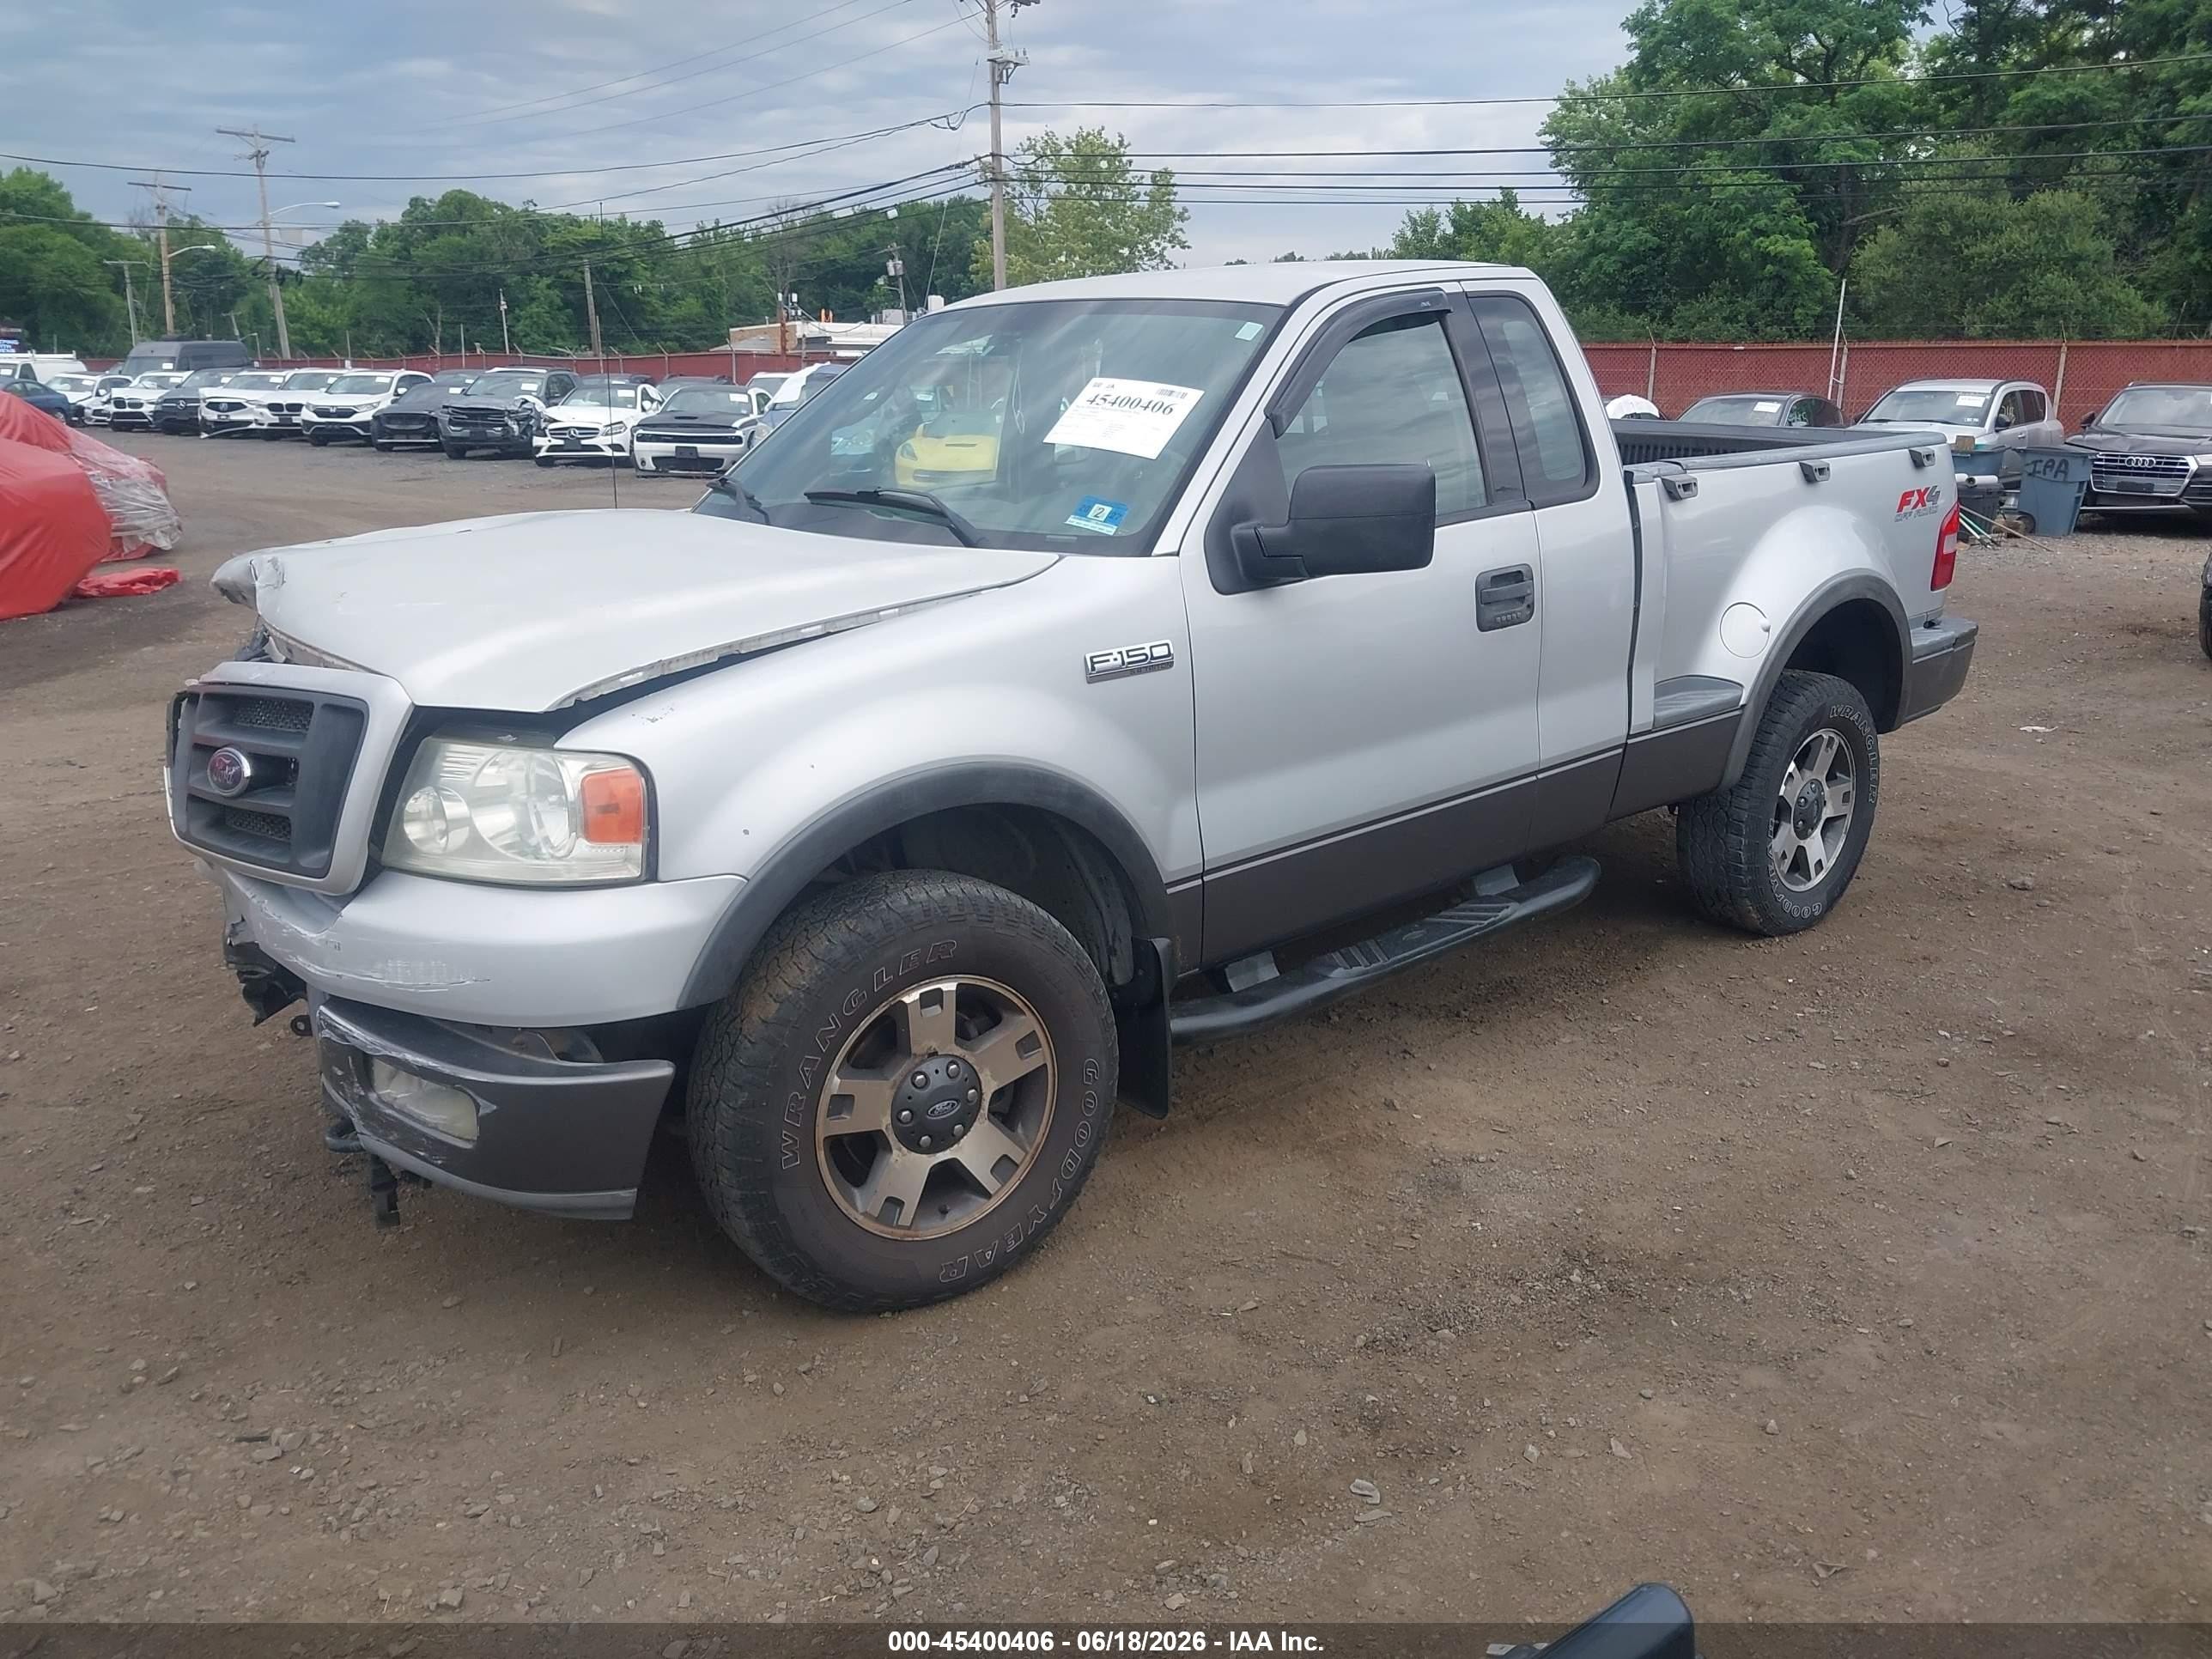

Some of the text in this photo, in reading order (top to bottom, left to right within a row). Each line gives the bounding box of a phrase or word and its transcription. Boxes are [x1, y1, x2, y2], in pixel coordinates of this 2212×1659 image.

[1086, 392, 1177, 416] 45400406
[2025, 458, 2069, 481] IAA
[1094, 507, 1105, 519] 2
[1896, 484, 1940, 513] FX4
[1088, 641, 1172, 674] F-150
[1829, 702, 1881, 805] WRANGLER
[781, 939, 959, 1170] WRANGLER
[938, 1057, 1100, 1284] GOODYEAR
